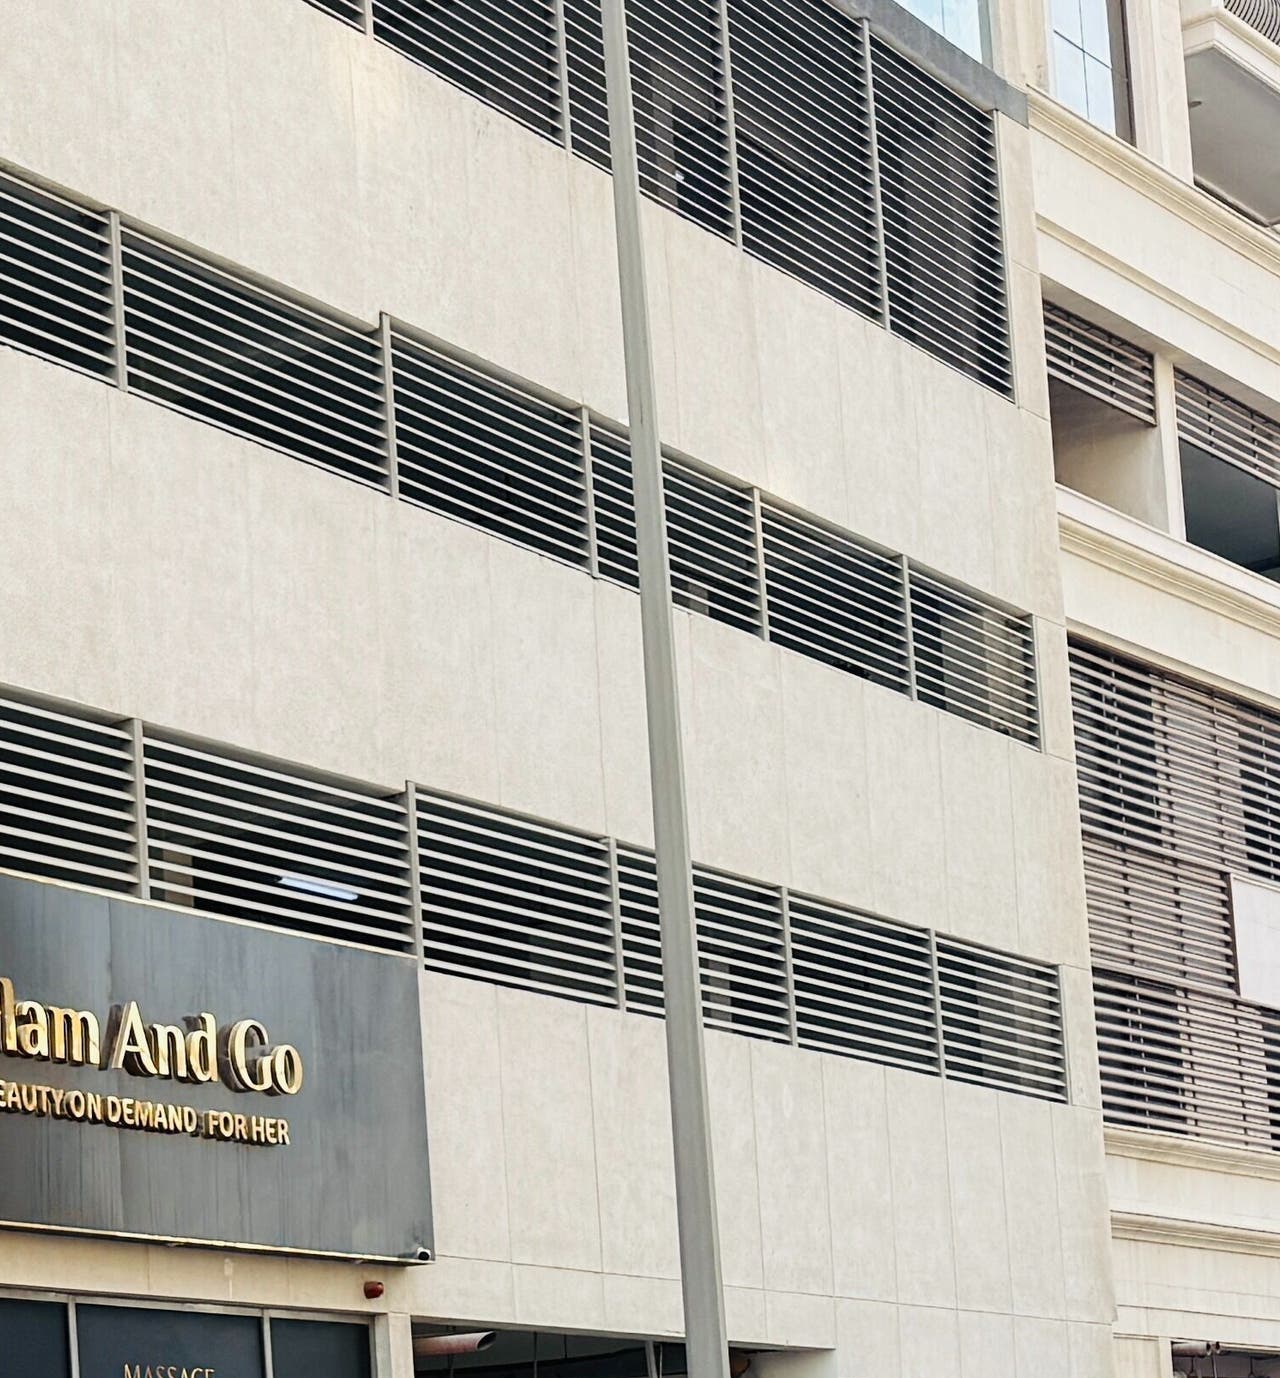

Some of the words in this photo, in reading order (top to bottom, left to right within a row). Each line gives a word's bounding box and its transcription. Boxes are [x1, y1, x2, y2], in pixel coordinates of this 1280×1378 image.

[110, 1001, 218, 1083] And
[225, 1019, 303, 1095] Go
[69, 1091, 102, 1122] ON
[107, 1097, 198, 1134] DEMAND
[205, 1109, 248, 1141] FOR
[252, 1117, 292, 1145] HER
